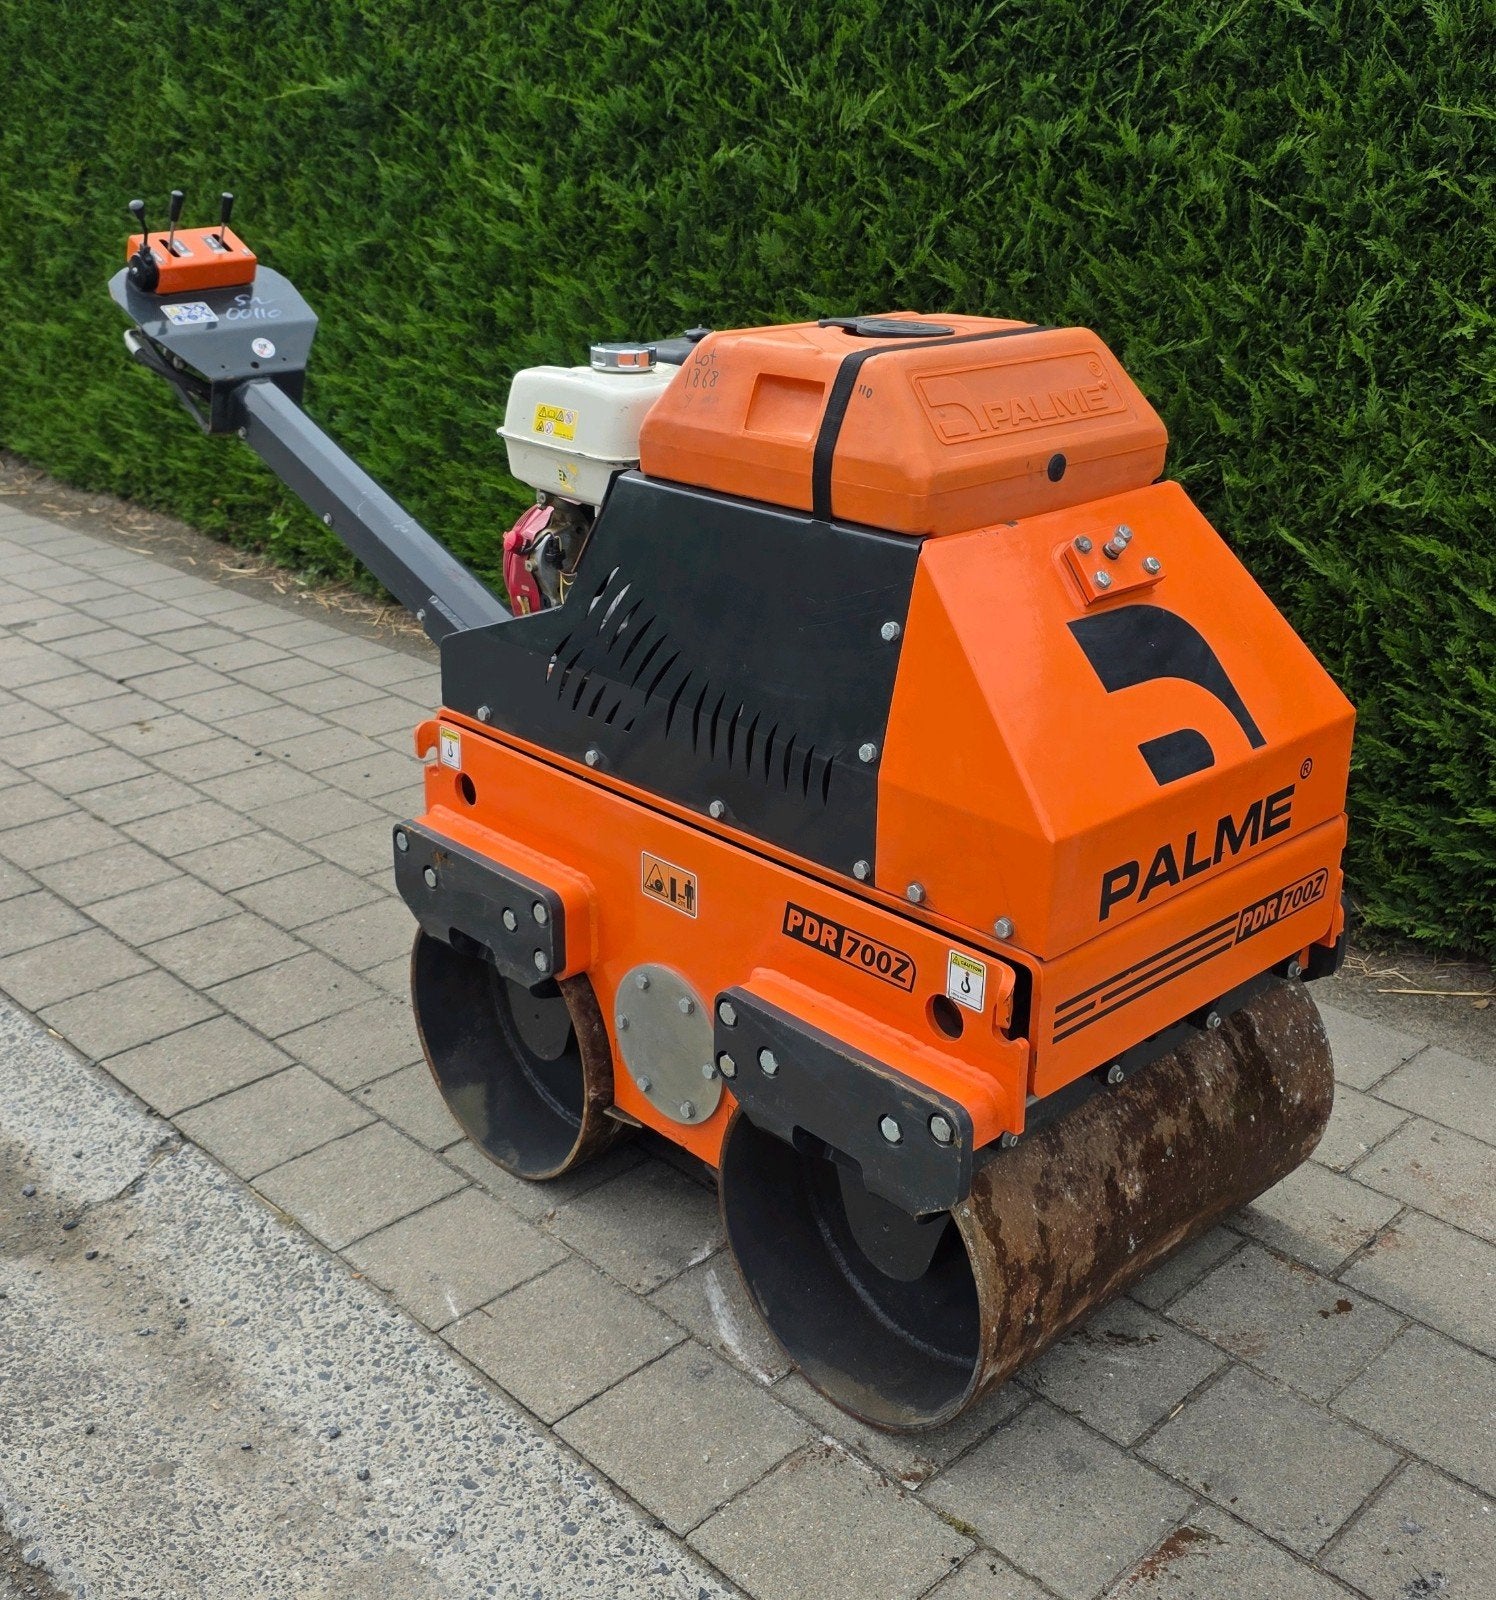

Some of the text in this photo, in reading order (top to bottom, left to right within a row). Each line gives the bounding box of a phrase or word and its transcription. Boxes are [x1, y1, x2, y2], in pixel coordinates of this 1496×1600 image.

[695, 347, 718, 366] Lot
[685, 368, 719, 389] 1868
[983, 387, 1109, 430] PALME
[1099, 783, 1296, 923] PALME
[787, 907, 911, 984] PDR 700Z
[960, 960, 982, 973] CAUTION
